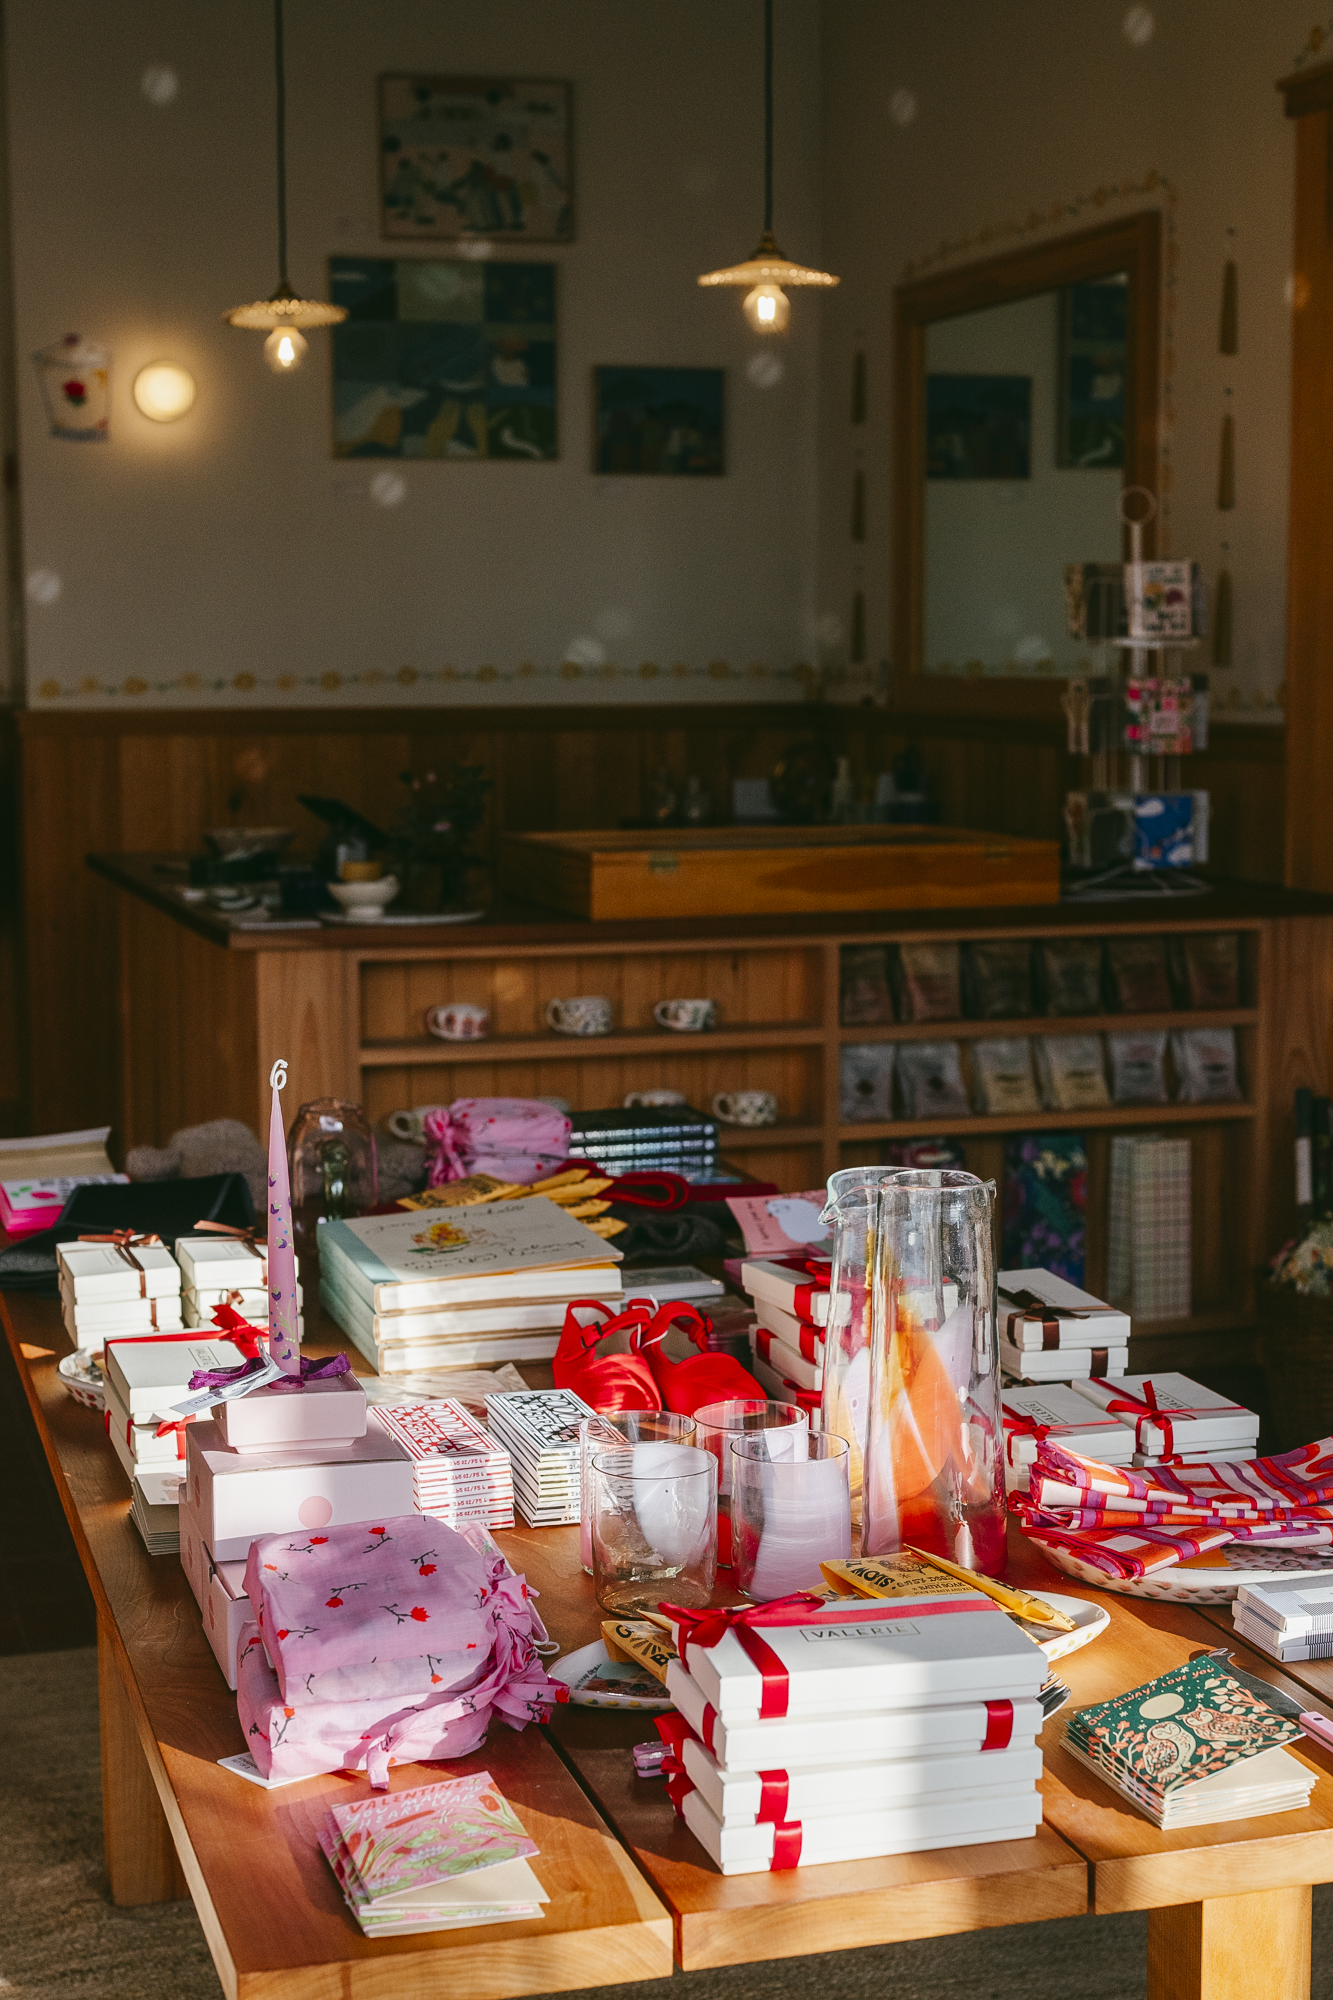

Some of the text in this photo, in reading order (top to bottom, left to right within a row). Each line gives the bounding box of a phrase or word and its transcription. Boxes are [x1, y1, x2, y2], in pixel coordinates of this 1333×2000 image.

[1025, 1402, 1060, 1424] VALERIE
[811, 1626, 909, 1639] VALERIE
[1088, 1710, 1110, 1726] OWL
[1112, 1686, 1156, 1708] ALWAYS
[1192, 1667, 1214, 1679] YOU
[344, 1785, 482, 1828] YOU MAKE MY
[349, 1780, 464, 1814] VALENTINE
[359, 1794, 475, 1830] HEART LEAP
